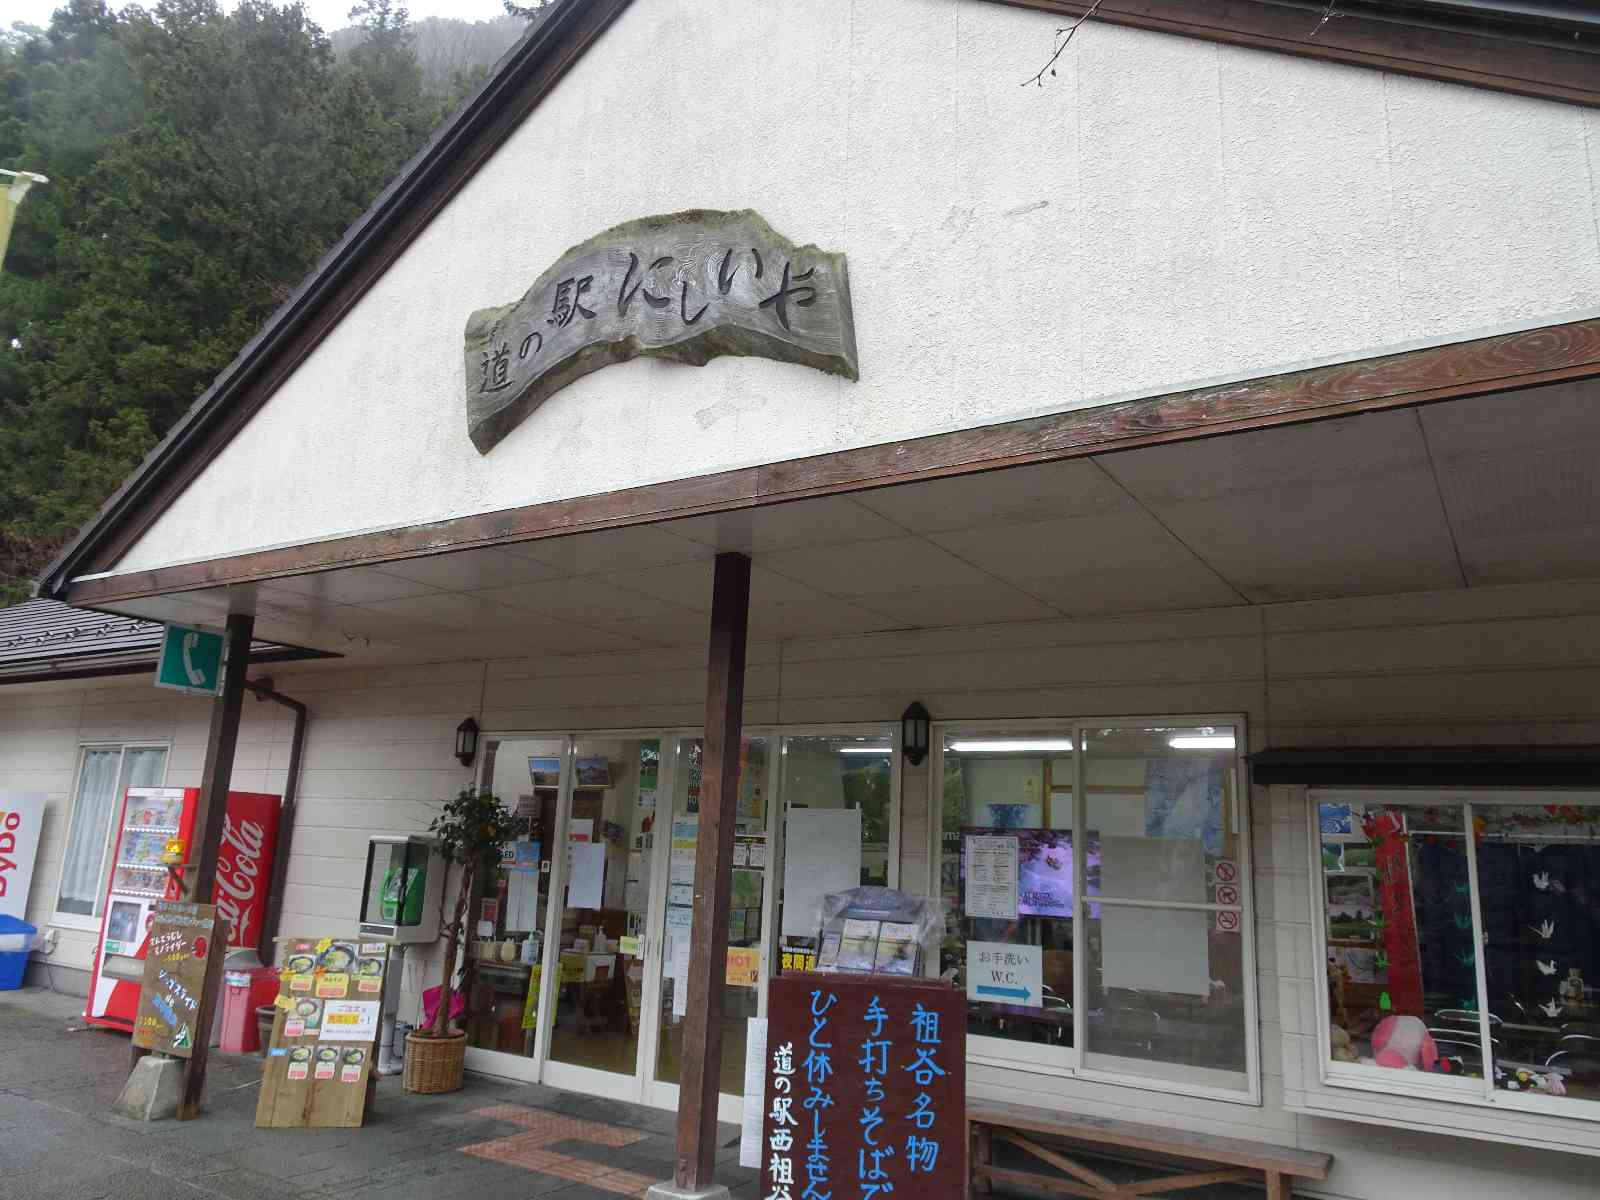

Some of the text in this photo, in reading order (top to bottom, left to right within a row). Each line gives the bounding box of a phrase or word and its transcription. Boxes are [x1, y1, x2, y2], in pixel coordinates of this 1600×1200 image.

[479, 247, 817, 394] 道の駅にしいや
[978, 951, 1030, 967] お手洗い
[991, 969, 1019, 985] W.C.
[801, 989, 840, 1200] ひと休みしません
[903, 1002, 946, 1174] 祖谷名物
